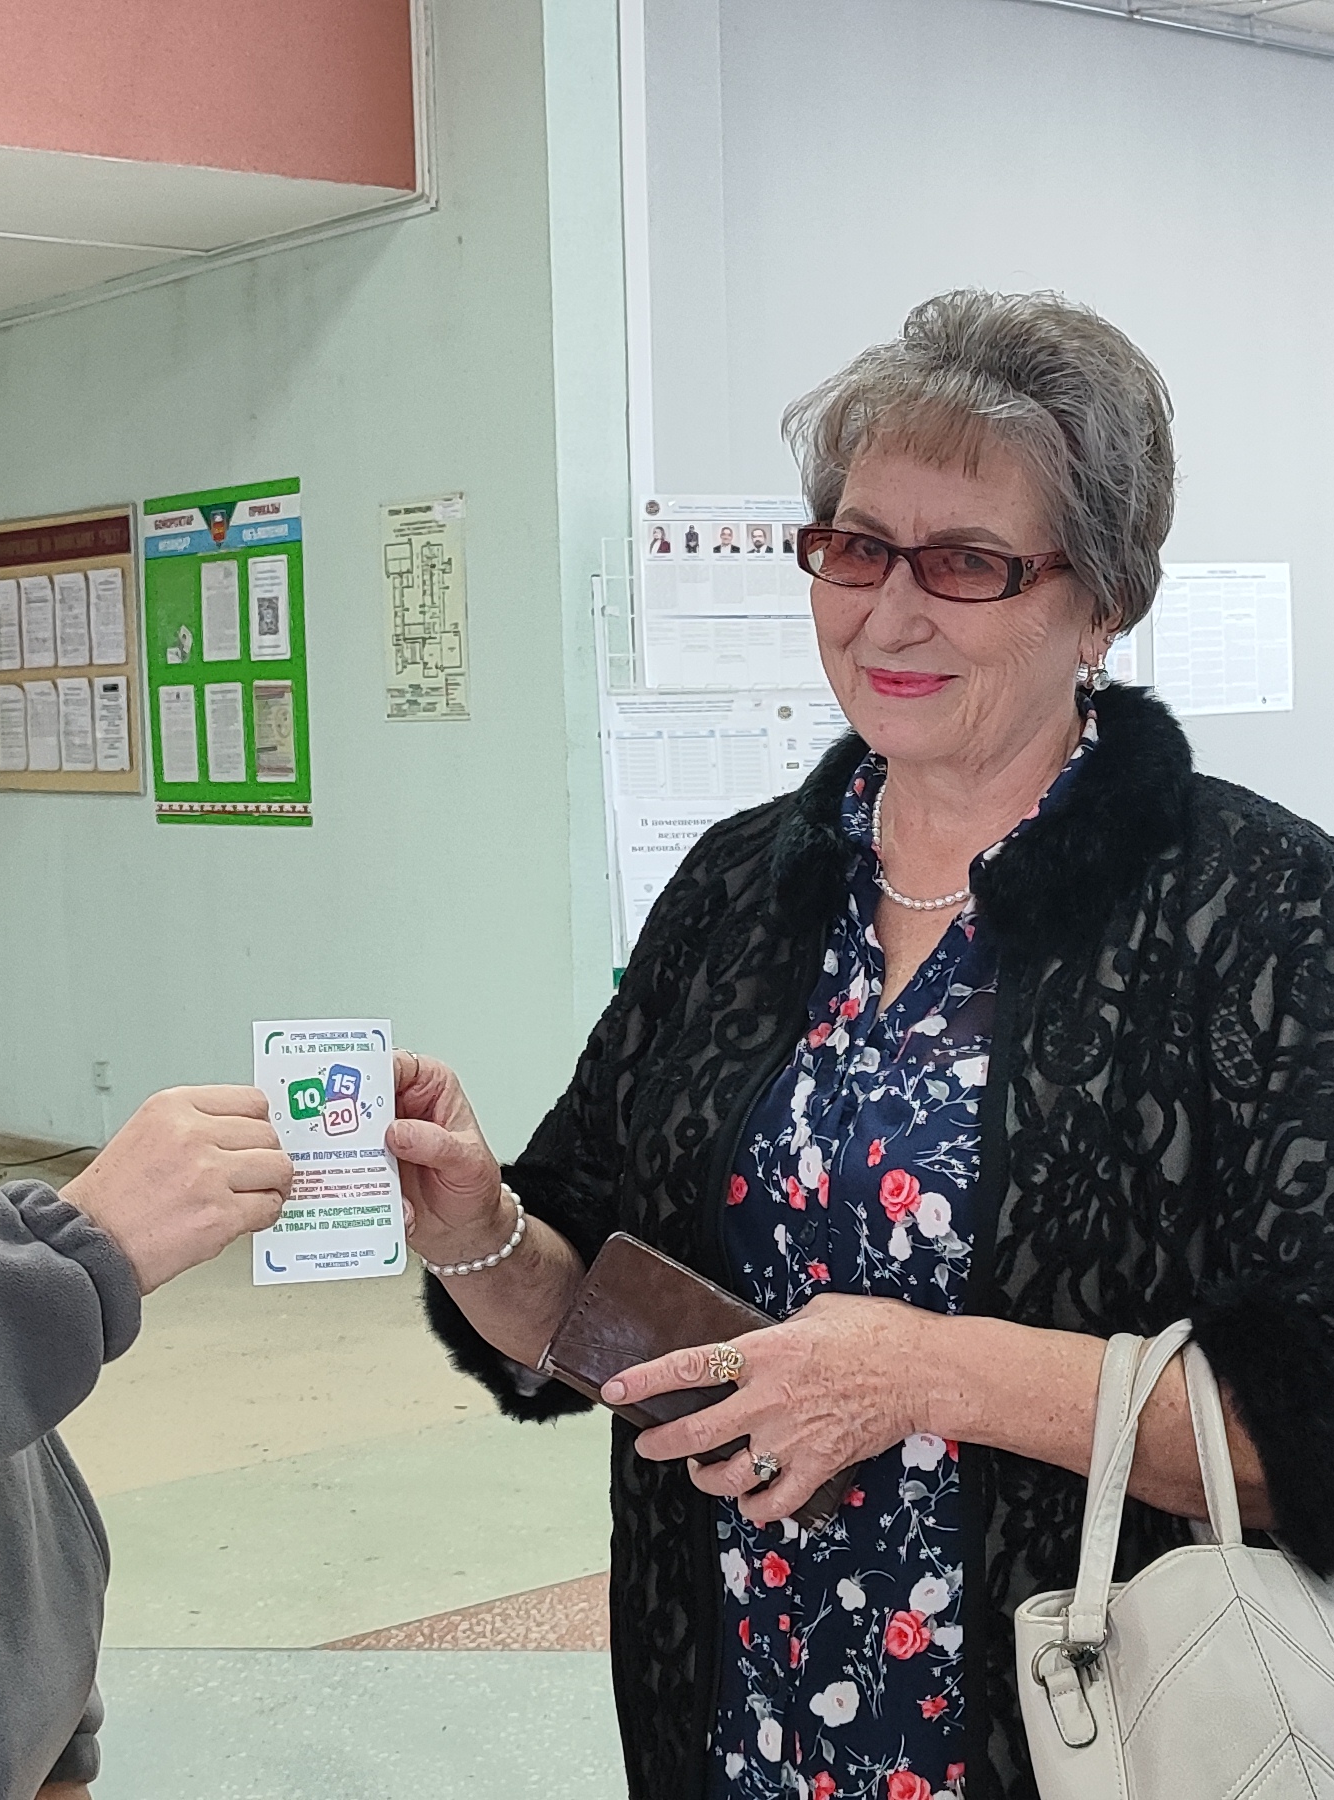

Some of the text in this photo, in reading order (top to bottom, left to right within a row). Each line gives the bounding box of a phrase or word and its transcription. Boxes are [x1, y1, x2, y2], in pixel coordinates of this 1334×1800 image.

[641, 819, 648, 827] В
[331, 1073, 356, 1095] 15
[293, 1087, 320, 1110] 10
[328, 1108, 352, 1126] 20
[285, 1222, 317, 1232] ТОВАРЫ
